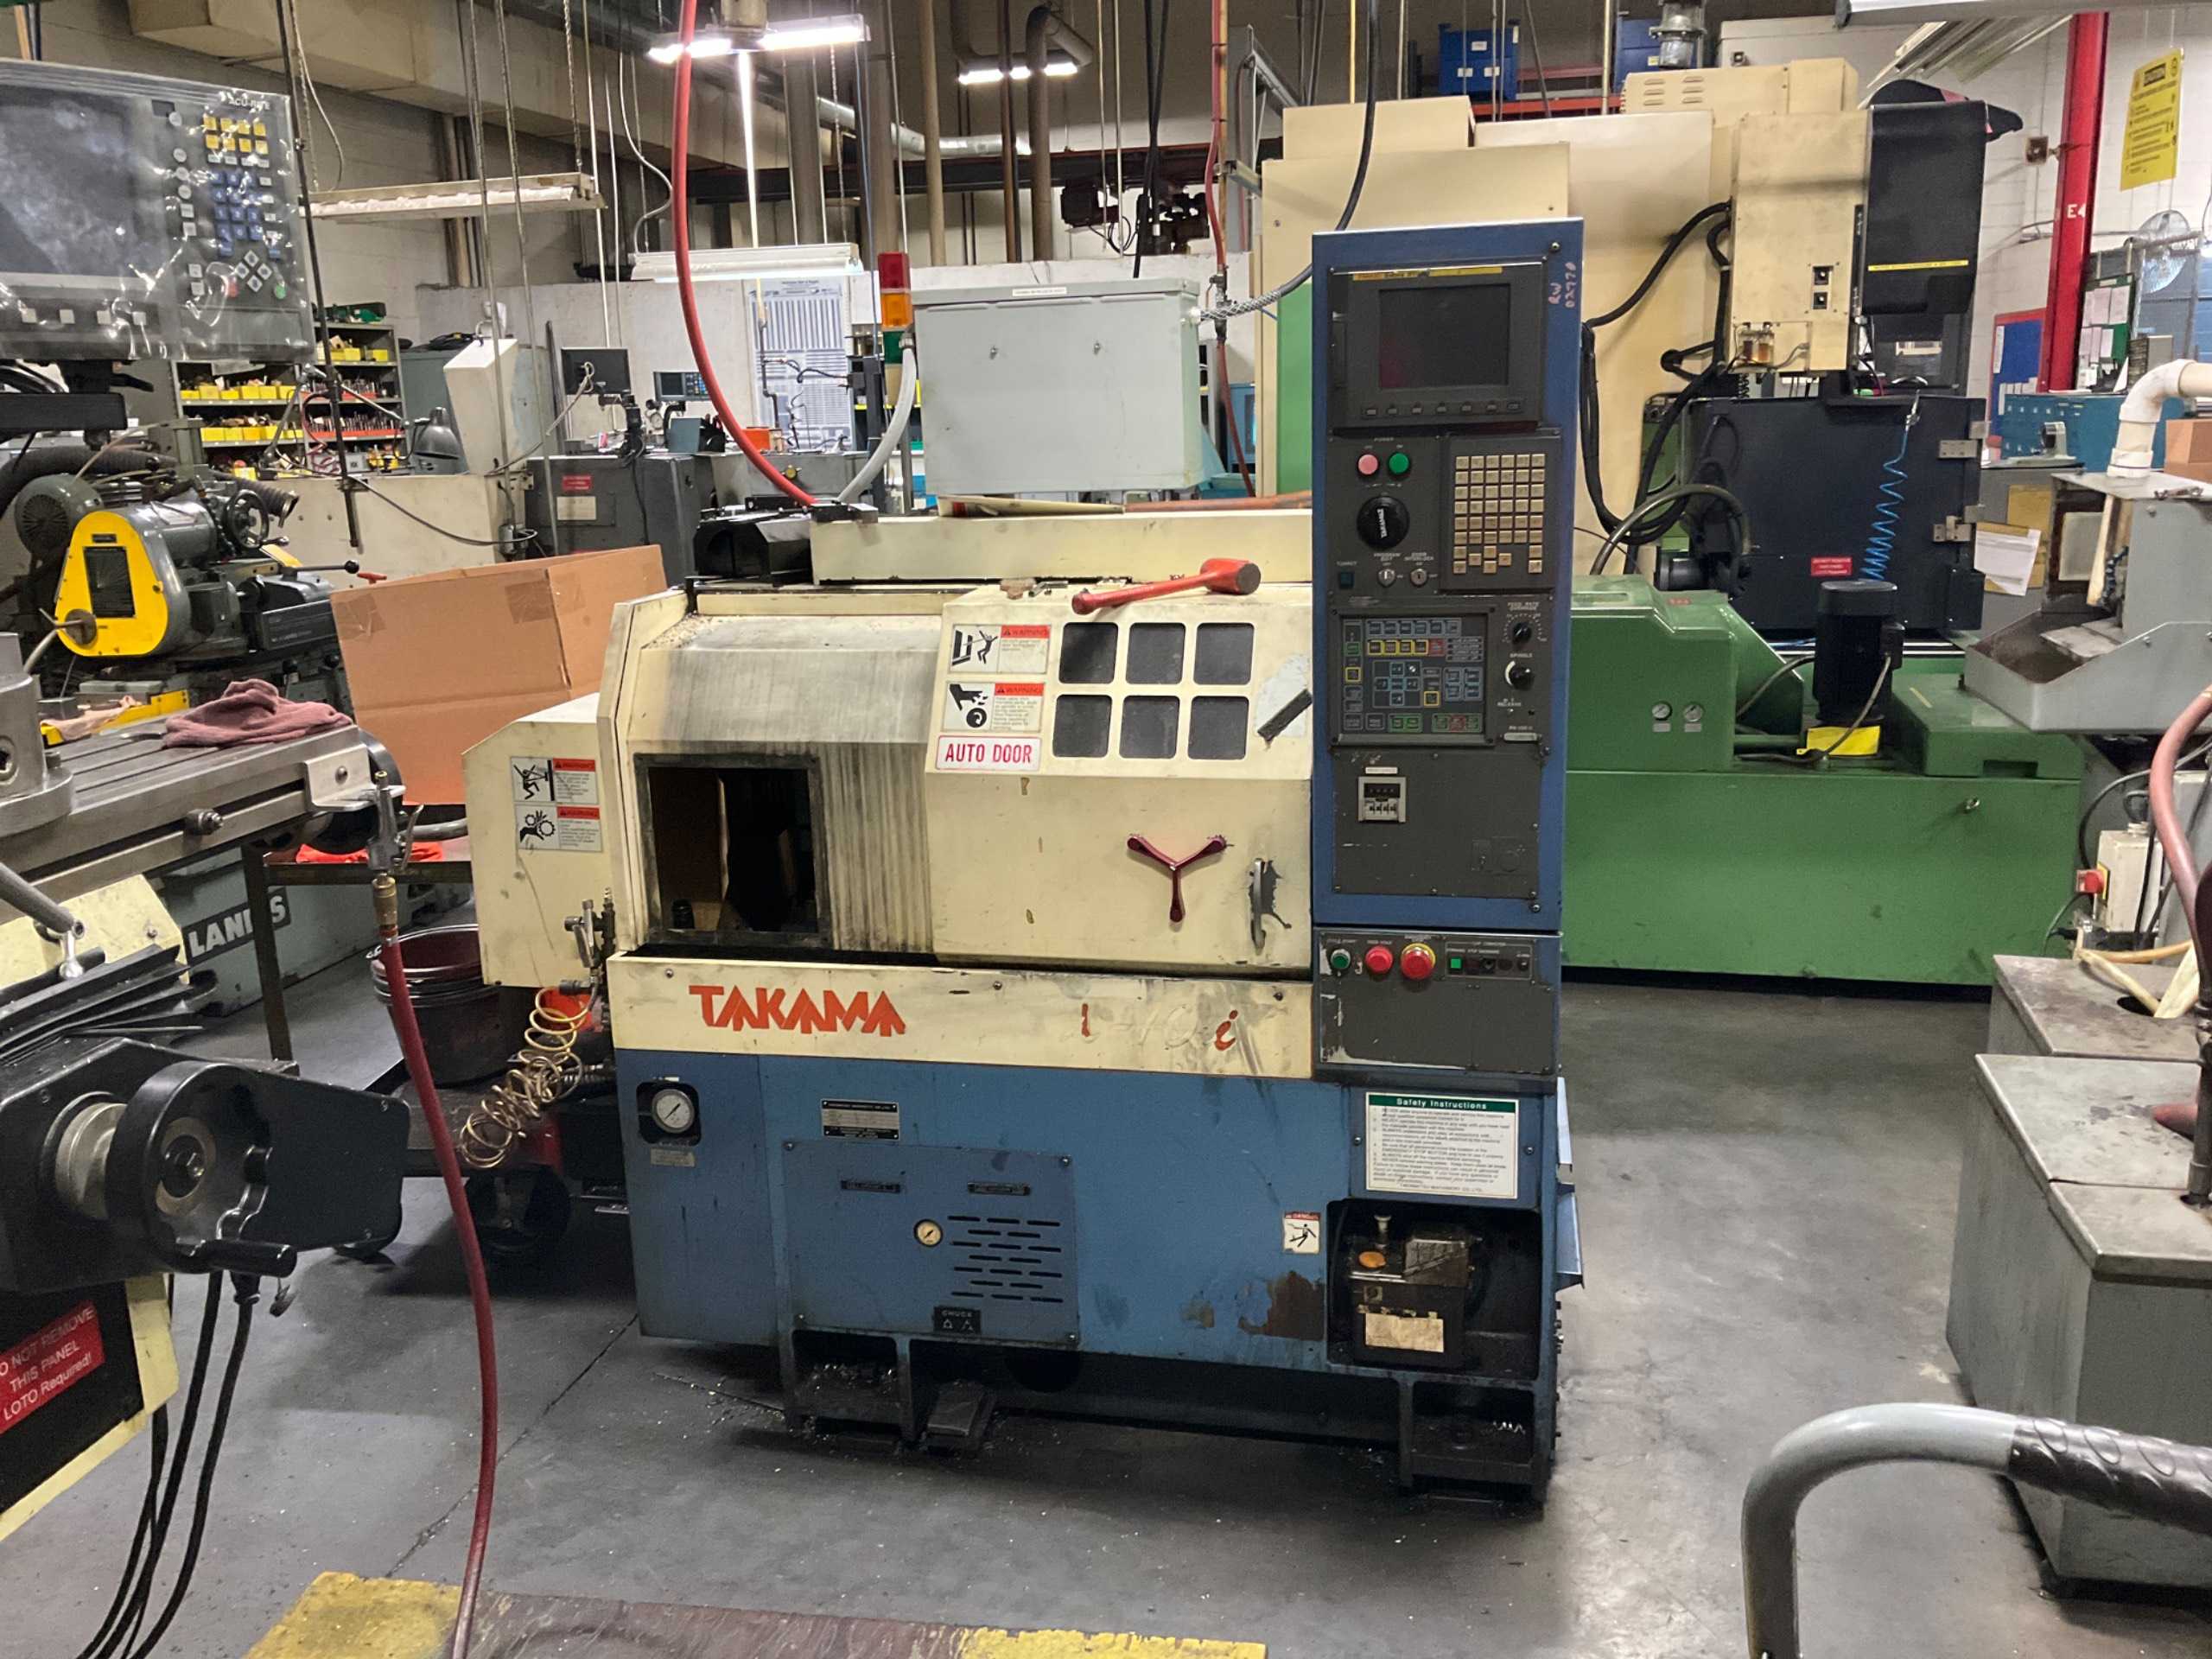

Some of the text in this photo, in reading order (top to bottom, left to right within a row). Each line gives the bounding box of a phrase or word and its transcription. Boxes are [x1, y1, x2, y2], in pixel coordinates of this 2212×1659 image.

[945, 743, 1033, 764] AUTO DOOR
[1396, 1097, 1487, 1110] Safety Instructions
[11, 1341, 39, 1370] NOT
[41, 1307, 96, 1346] REMOVE
[10, 1340, 81, 1392] THIS PANEL
[3, 1389, 38, 1421] LOTO
